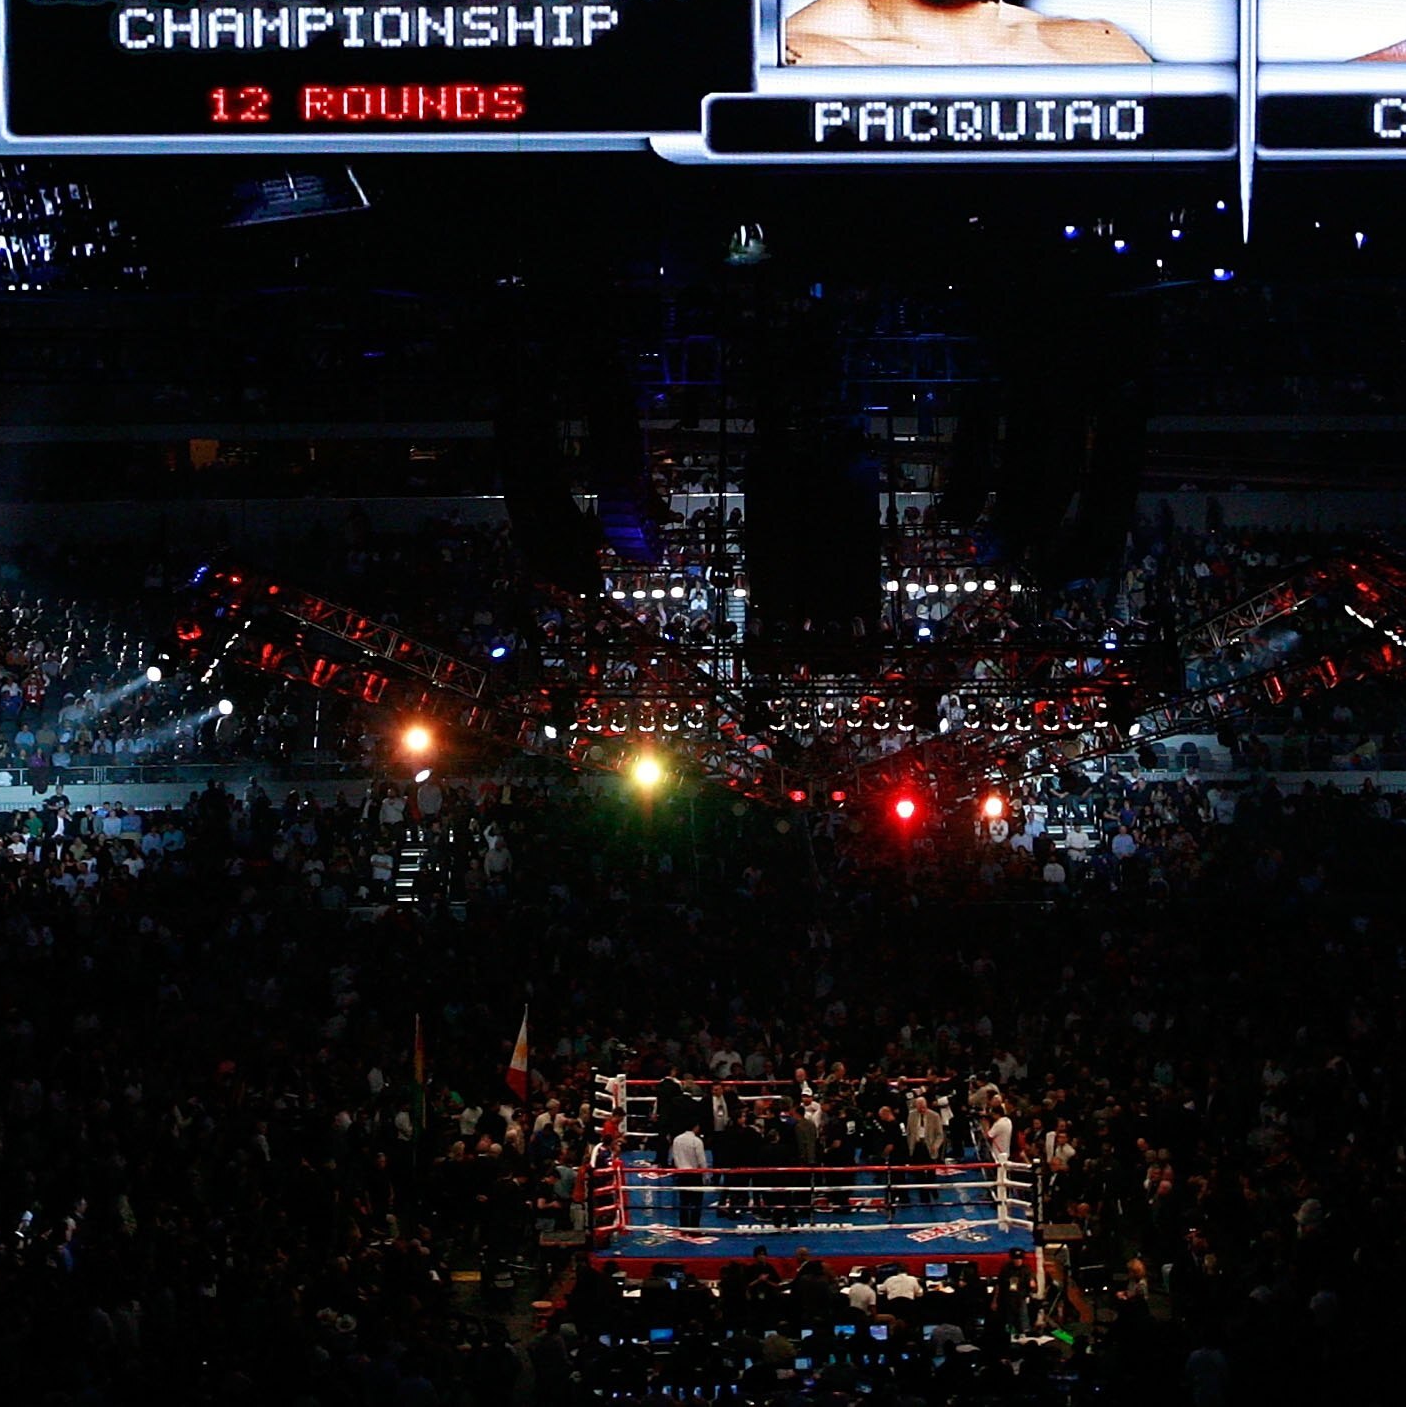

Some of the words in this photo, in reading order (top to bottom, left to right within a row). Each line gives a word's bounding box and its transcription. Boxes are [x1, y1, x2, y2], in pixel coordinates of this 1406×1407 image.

[118, 5, 619, 50] CHAMPIONSHIP
[210, 86, 272, 122] 12
[304, 85, 525, 121] ROUNDS
[814, 100, 1144, 142] PACQUIAO
